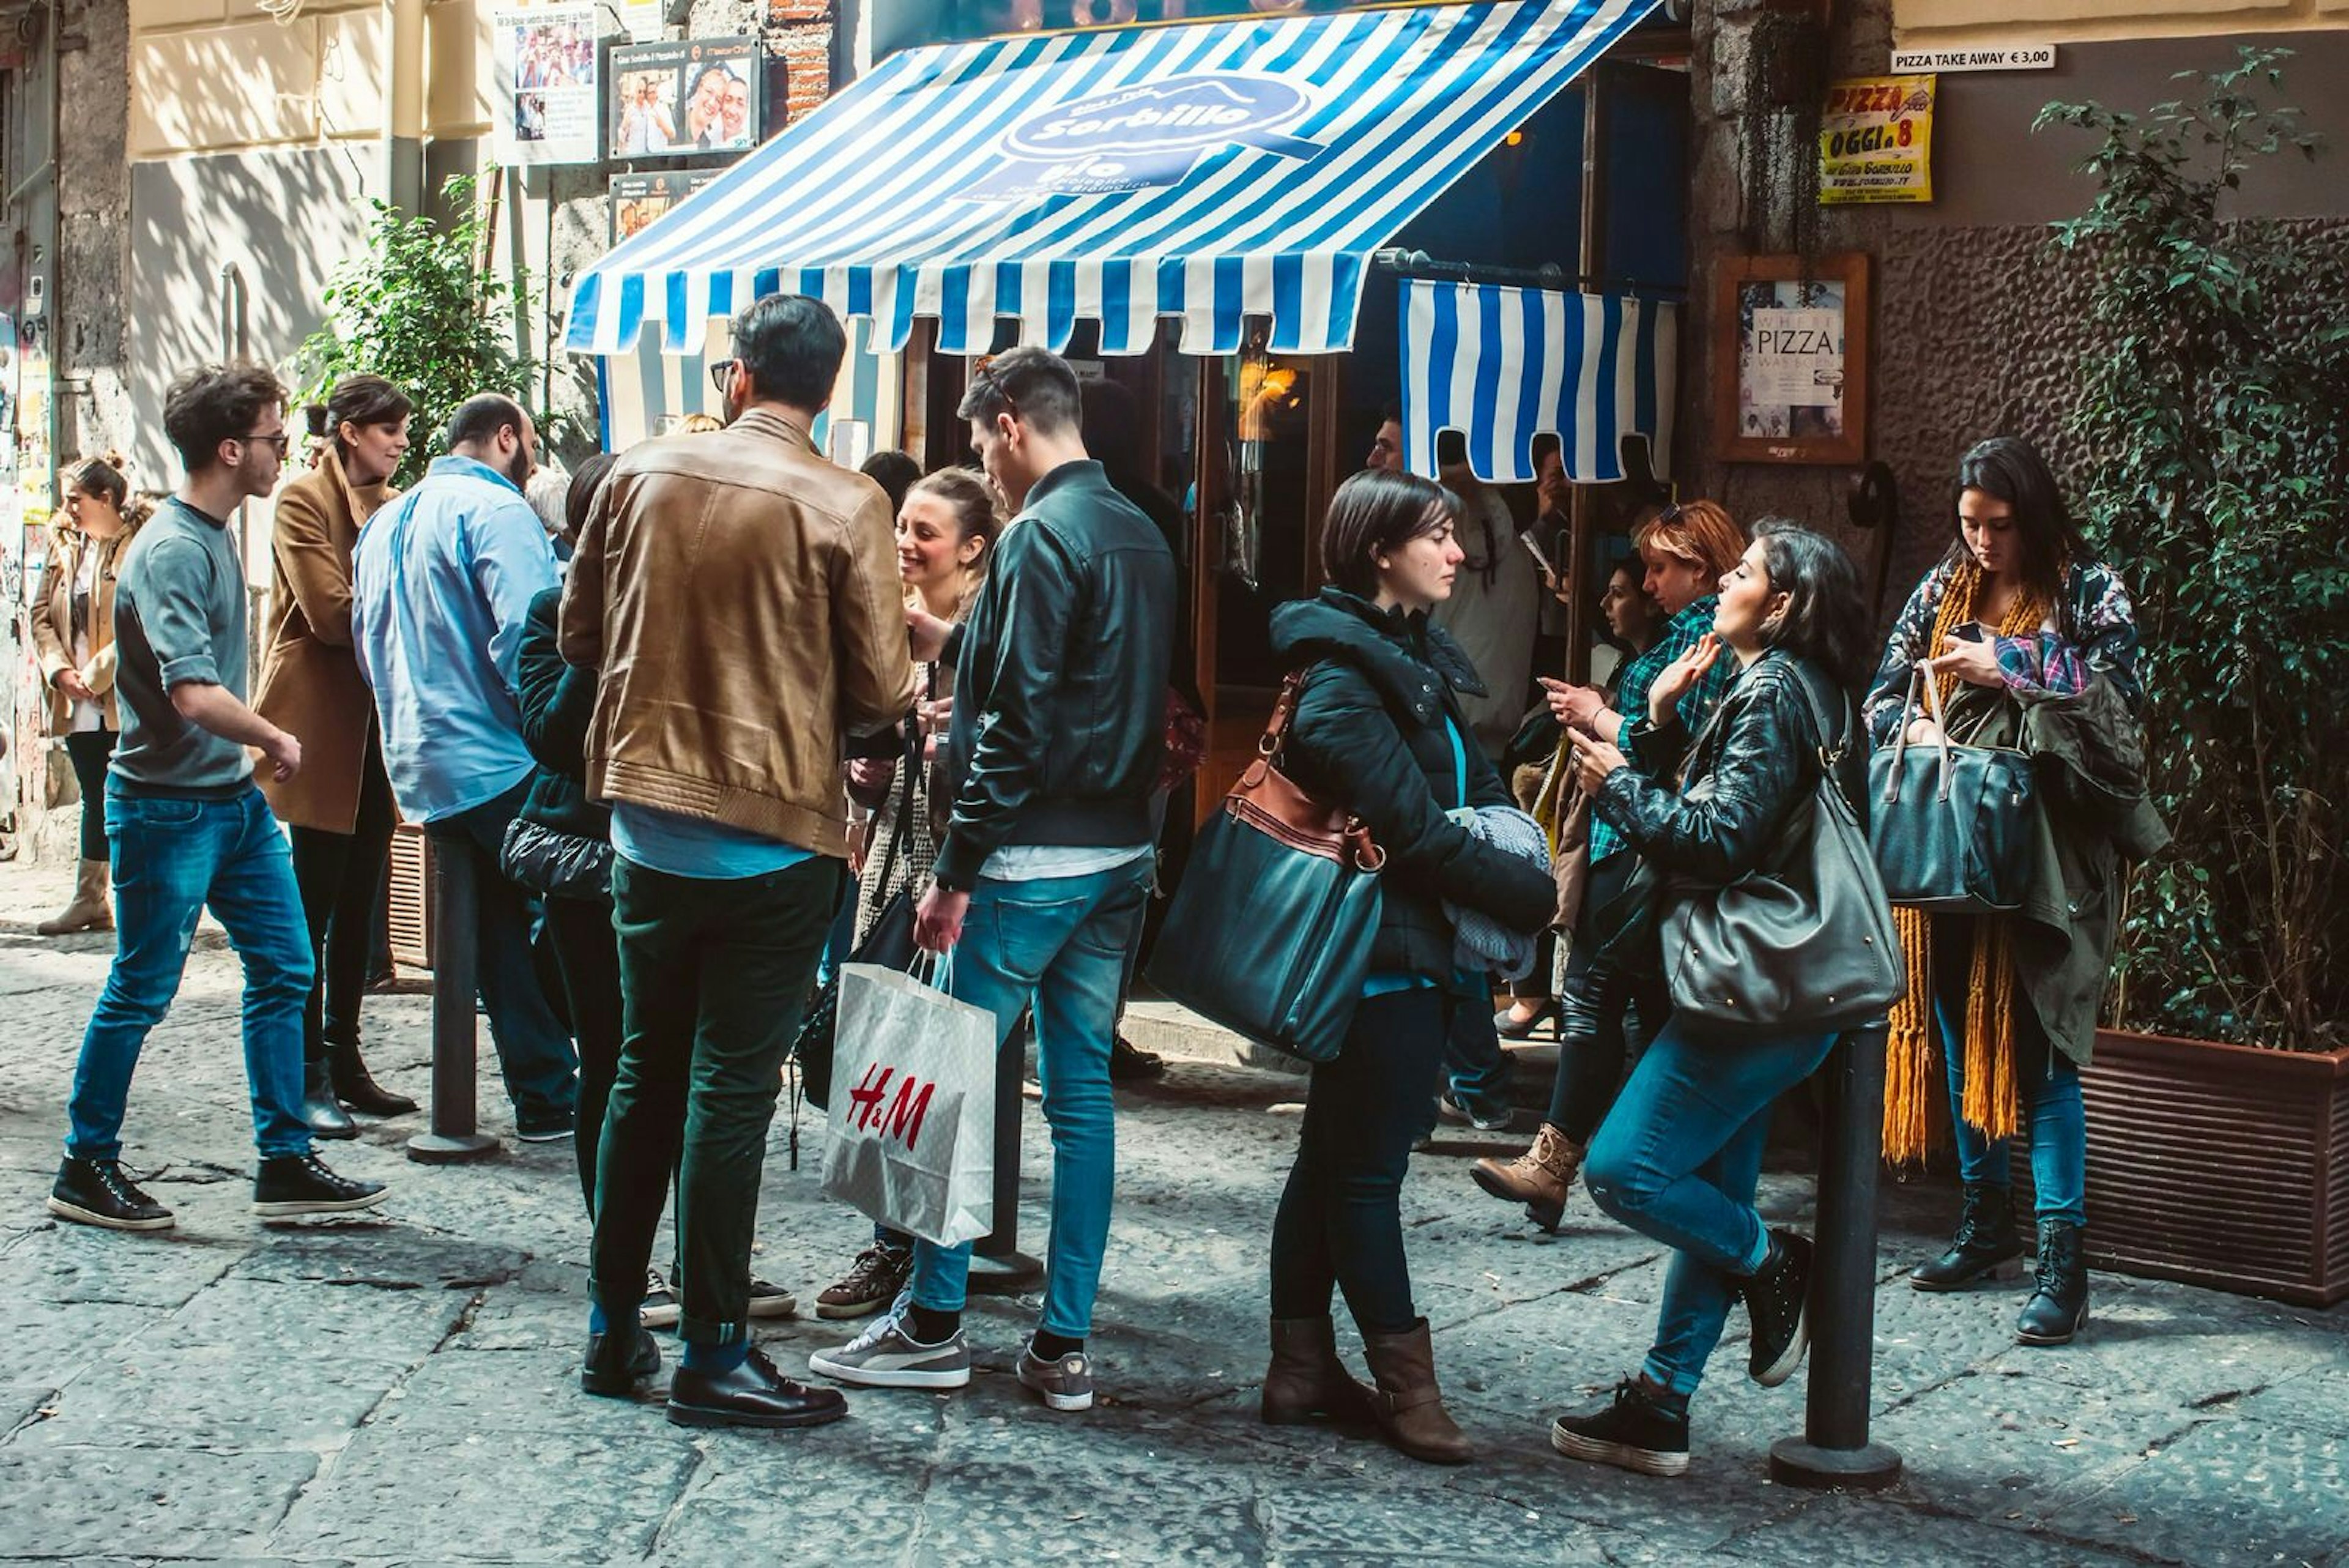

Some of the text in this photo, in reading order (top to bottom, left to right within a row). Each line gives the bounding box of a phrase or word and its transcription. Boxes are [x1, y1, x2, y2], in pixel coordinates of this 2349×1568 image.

[1896, 51, 2049, 67] PIZZA TAKE AWAY € 3,00
[1828, 86, 1901, 113] PIZZA
[1830, 125, 1883, 158] OGGI
[1898, 119, 1913, 147] 8
[1758, 330, 1833, 354] PIZZA
[847, 1062, 935, 1152] H&M
